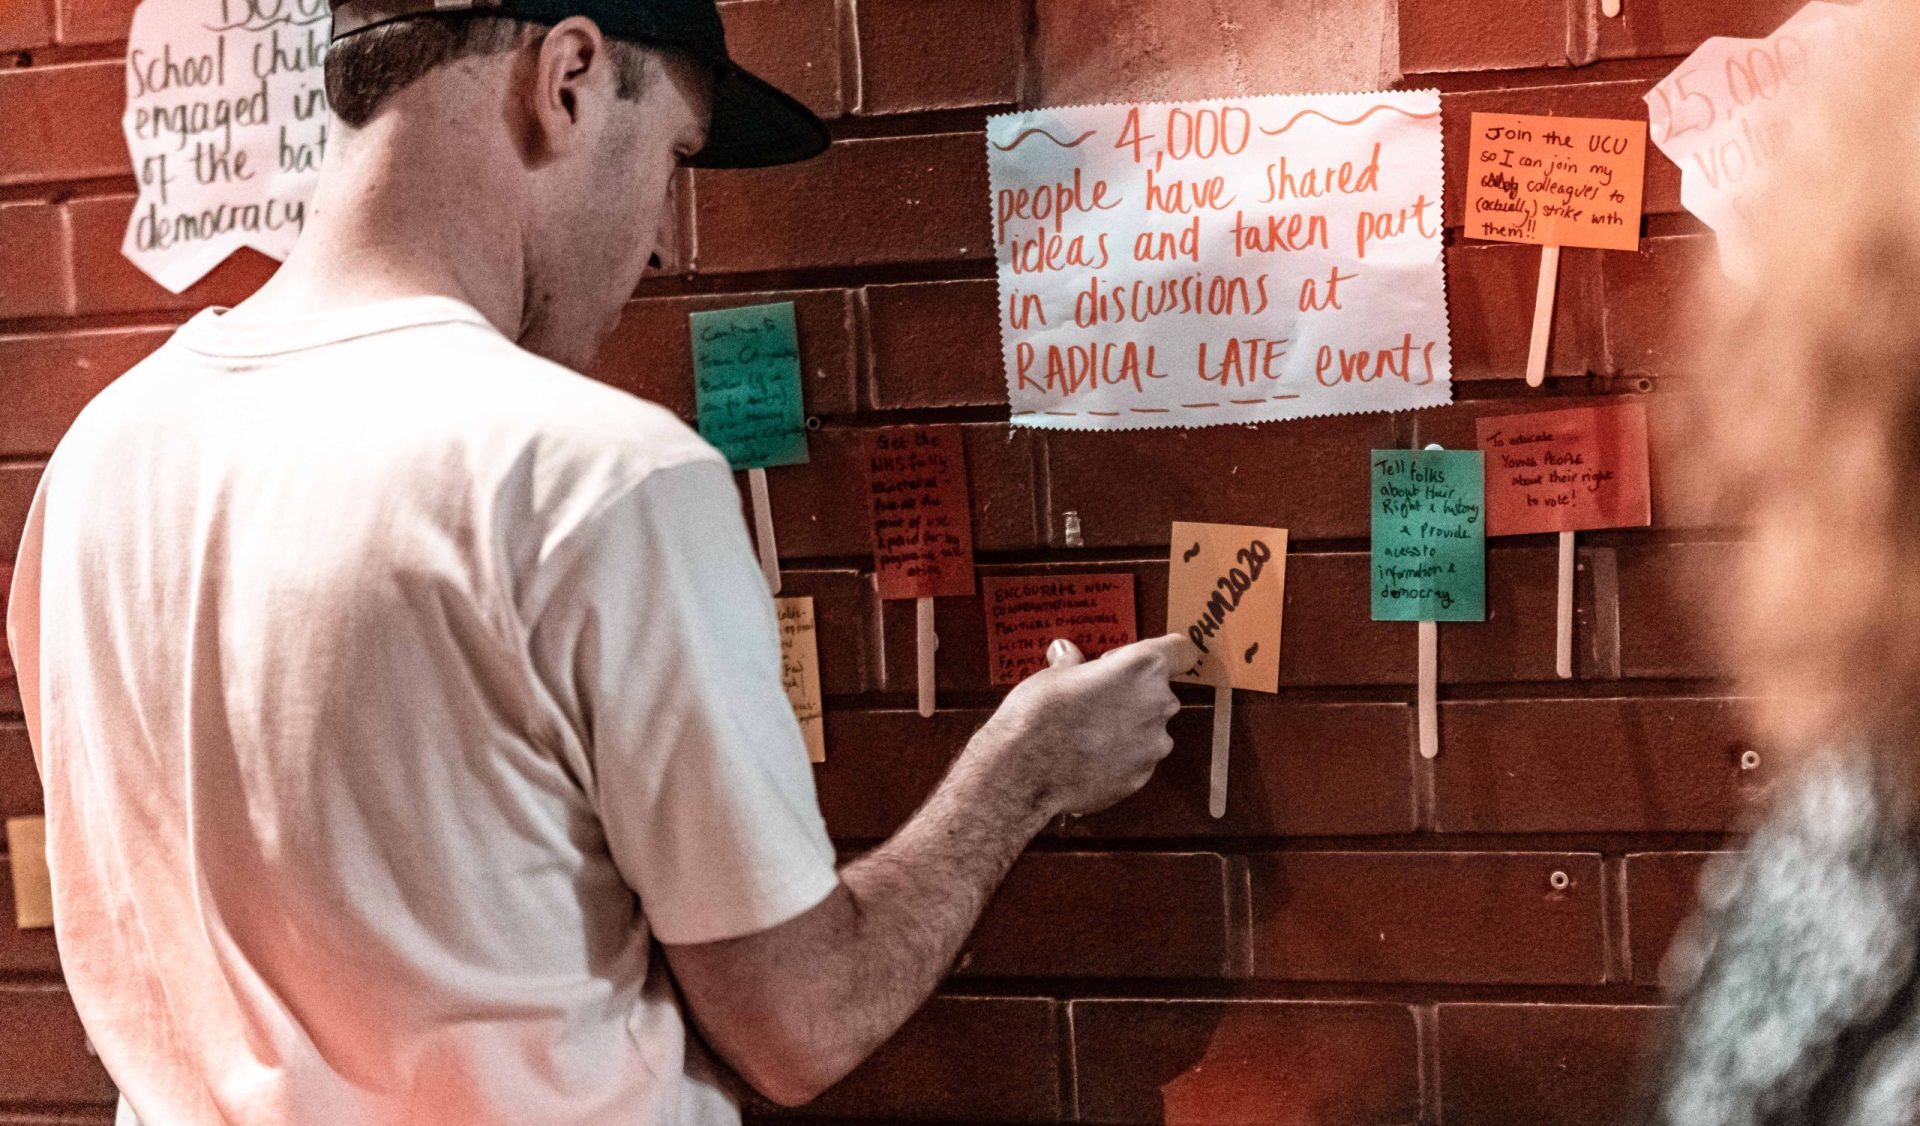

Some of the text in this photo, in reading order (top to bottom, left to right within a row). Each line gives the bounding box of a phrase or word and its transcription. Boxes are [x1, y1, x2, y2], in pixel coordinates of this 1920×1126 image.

[131, 34, 225, 99] School
[134, 78, 268, 156] engaged
[1114, 106, 1252, 171] 4,000
[1485, 120, 1629, 155] Join the UCU
[142, 153, 177, 205] of
[187, 141, 256, 185] the
[1480, 149, 1613, 187] so I can join my
[999, 142, 1381, 244] people have shared
[1526, 176, 1600, 206] colleagues
[1610, 189, 1625, 203] to
[136, 198, 304, 252] democracy
[1542, 204, 1583, 222] strike
[1591, 211, 1624, 226] with
[1011, 194, 1437, 276] ideas and taken part
[1010, 265, 1360, 330] in discussions at
[1016, 333, 1436, 397] RADICAL LATE events
[914, 431, 940, 447] the
[1486, 431, 1554, 448] To educate
[1374, 459, 1404, 476] Tell
[1511, 468, 1614, 493] about their right
[1380, 481, 1420, 499] about
[1382, 498, 1421, 518] Right
[1527, 494, 1540, 507] to
[1377, 563, 1442, 585] information
[1186, 540, 1271, 677] PHM2020
